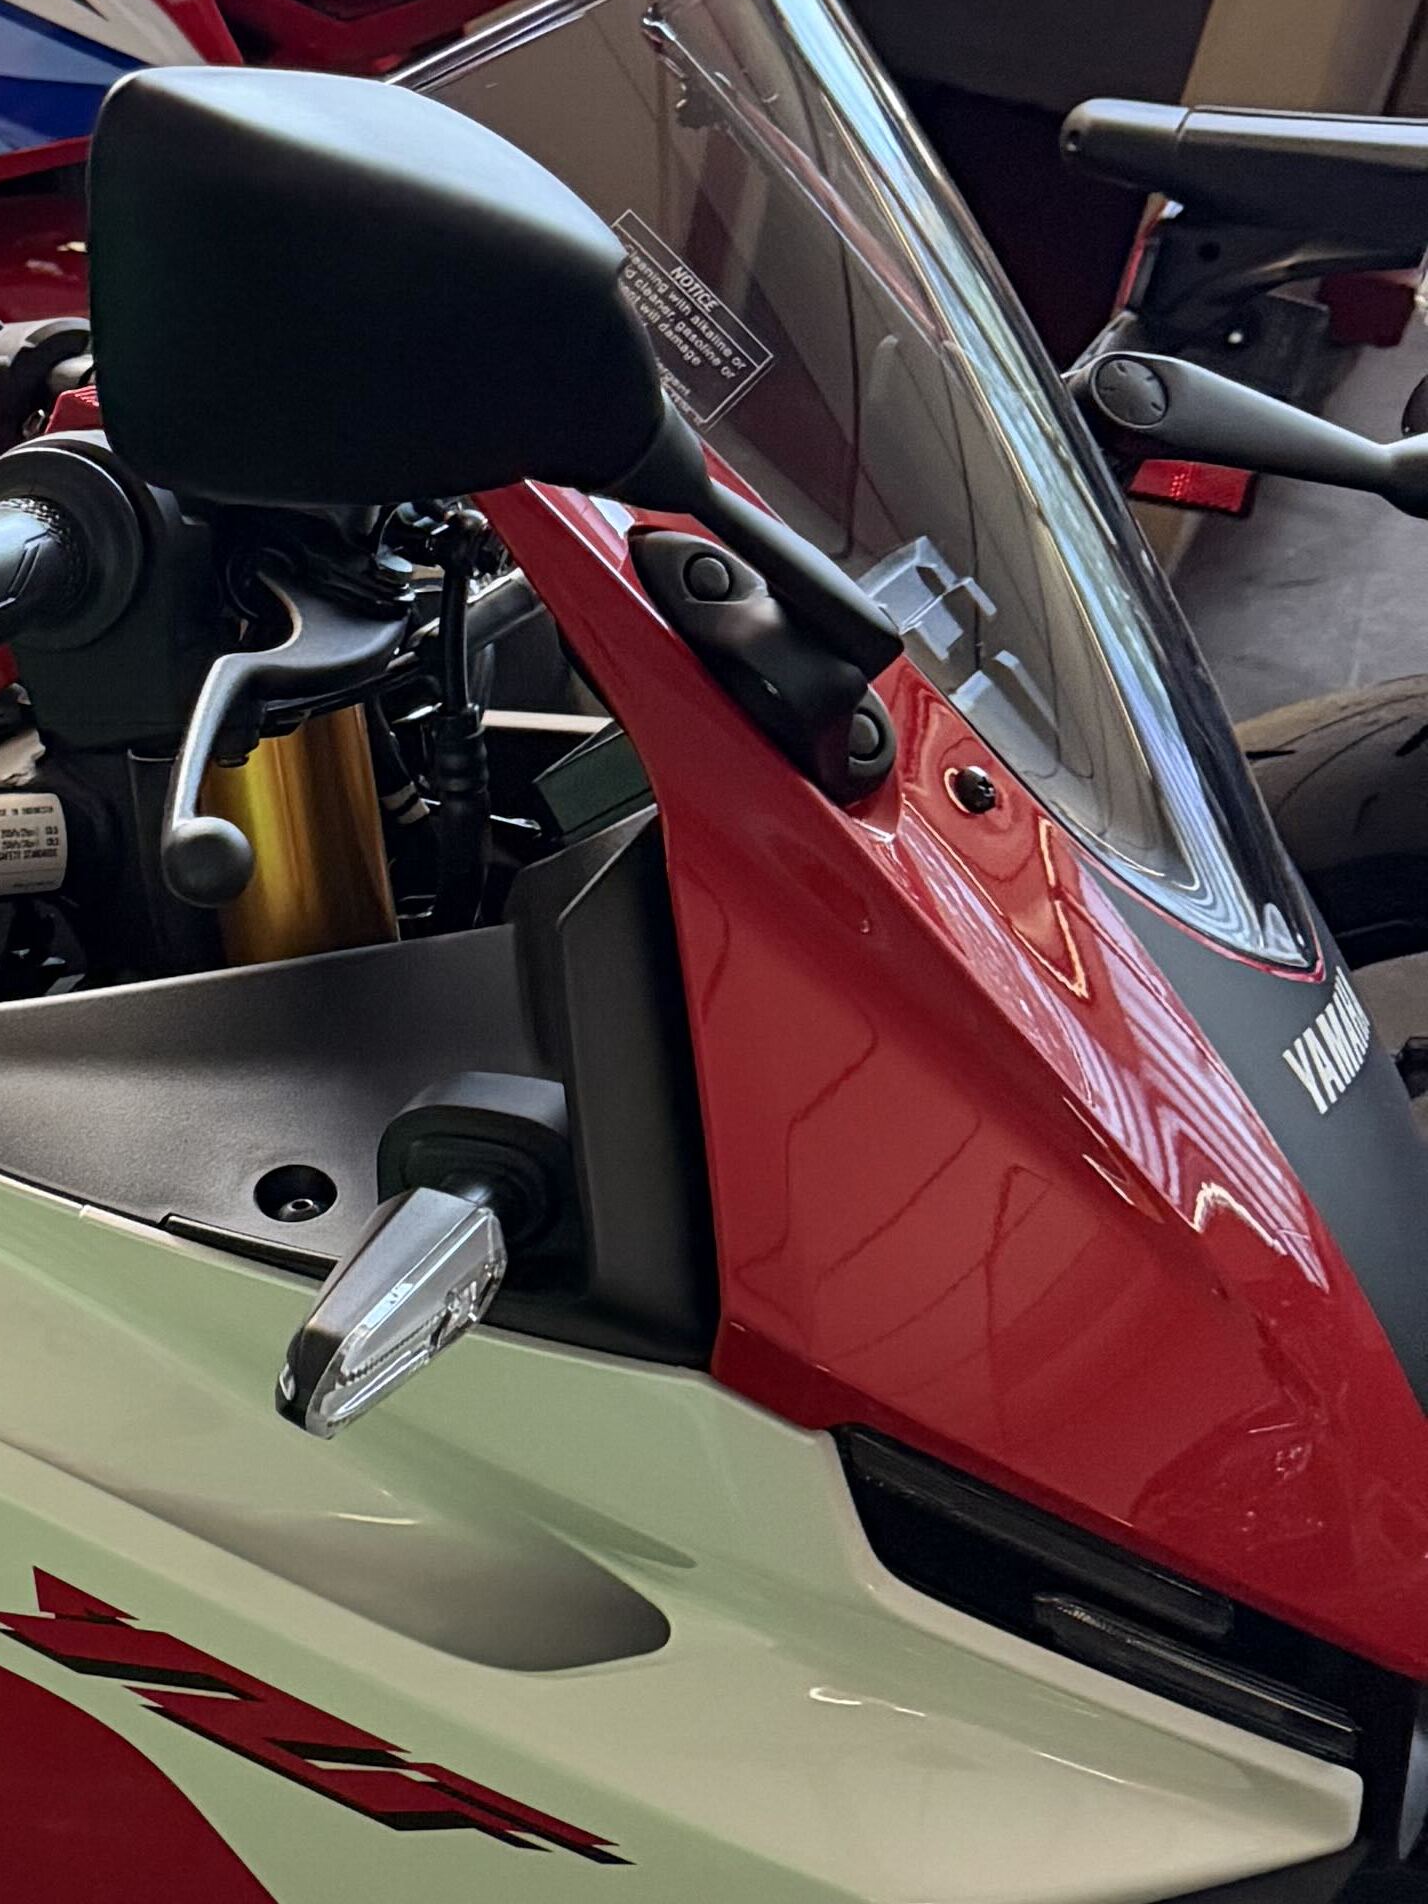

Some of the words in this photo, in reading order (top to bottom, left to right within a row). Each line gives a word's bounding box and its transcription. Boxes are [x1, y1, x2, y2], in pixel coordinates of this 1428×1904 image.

[670, 265, 719, 313] NOTICE
[640, 302, 661, 324] will
[658, 322, 702, 366] damage
[669, 290, 692, 316] with
[690, 314, 733, 358] alkaline
[732, 357, 747, 370] or
[674, 321, 722, 367] gasoline
[721, 365, 736, 380] or
